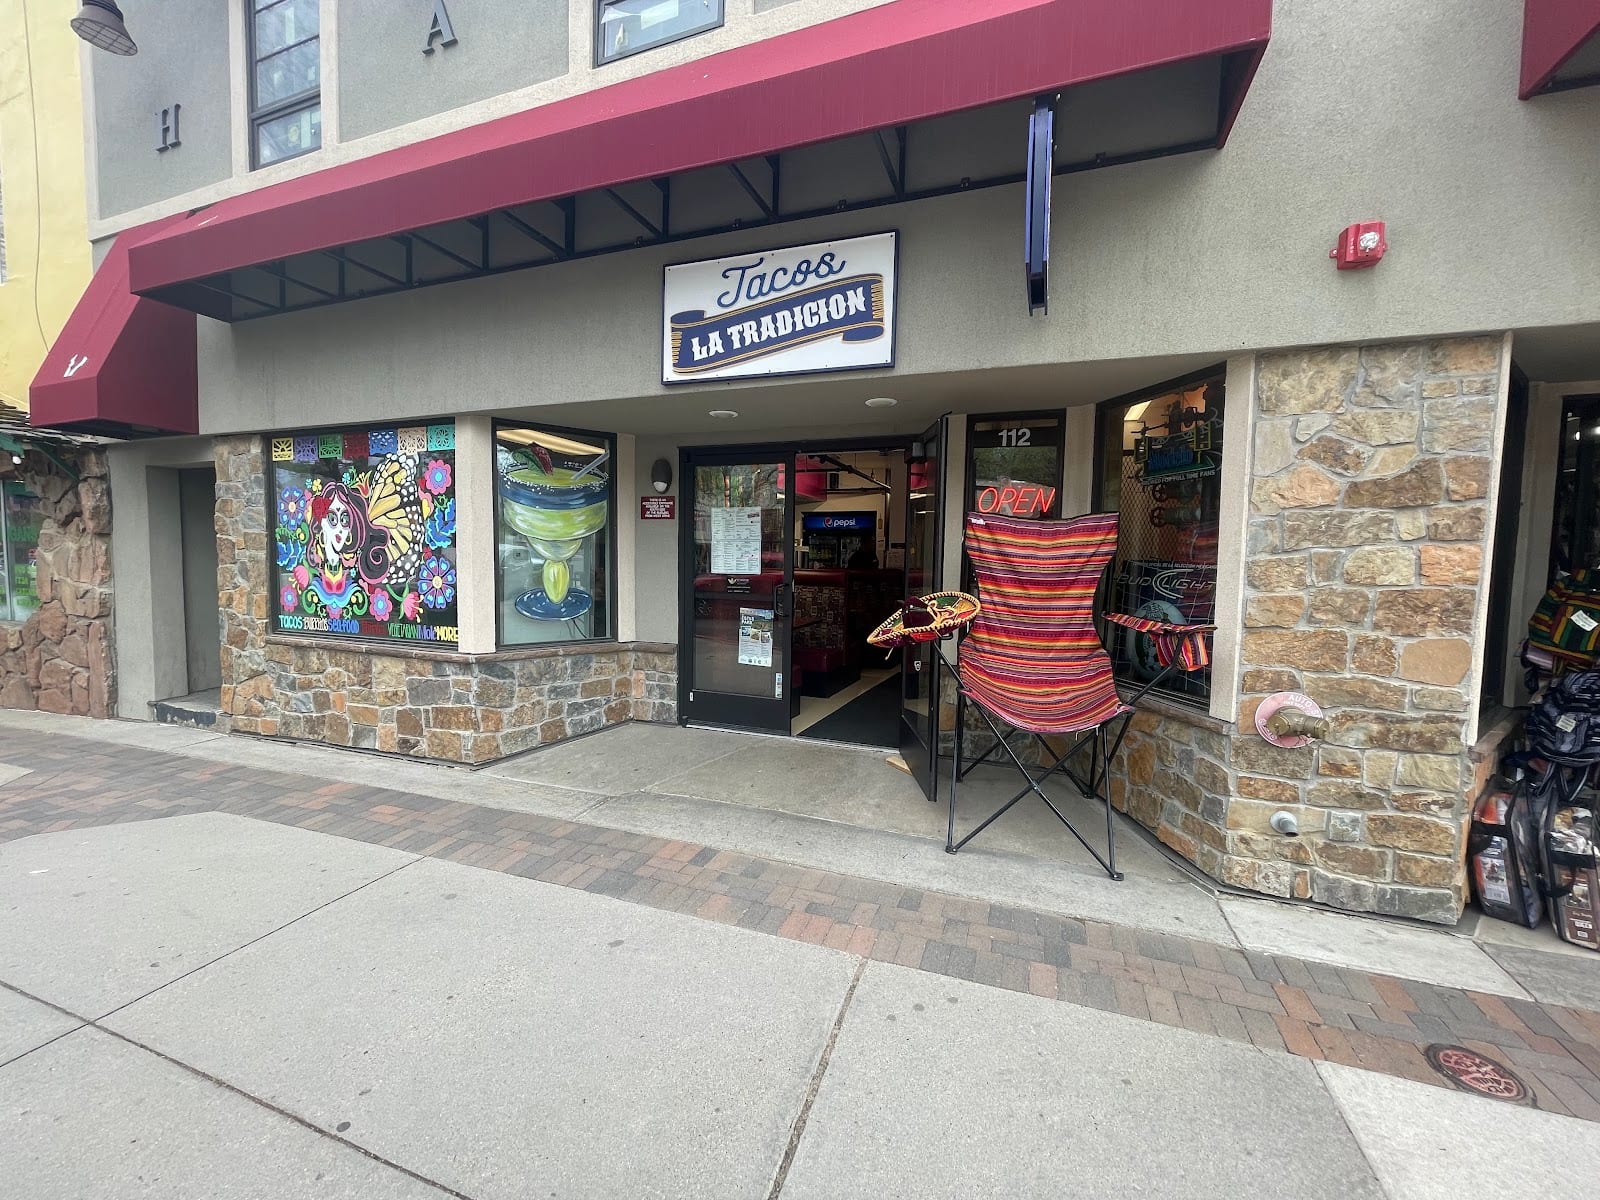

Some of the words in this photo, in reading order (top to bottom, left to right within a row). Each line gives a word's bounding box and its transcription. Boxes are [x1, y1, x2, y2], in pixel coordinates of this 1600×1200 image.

[421, 0, 459, 54] A
[156, 103, 182, 152] H
[717, 252, 847, 308] Tacos
[691, 330, 725, 361] LA
[727, 286, 867, 350] TRADICION
[998, 428, 1031, 447] 112
[978, 487, 1056, 514] OPEN
[833, 517, 857, 528] pepsi
[1160, 577, 1217, 590] LIGHT
[1288, 694, 1312, 708] AUTO
